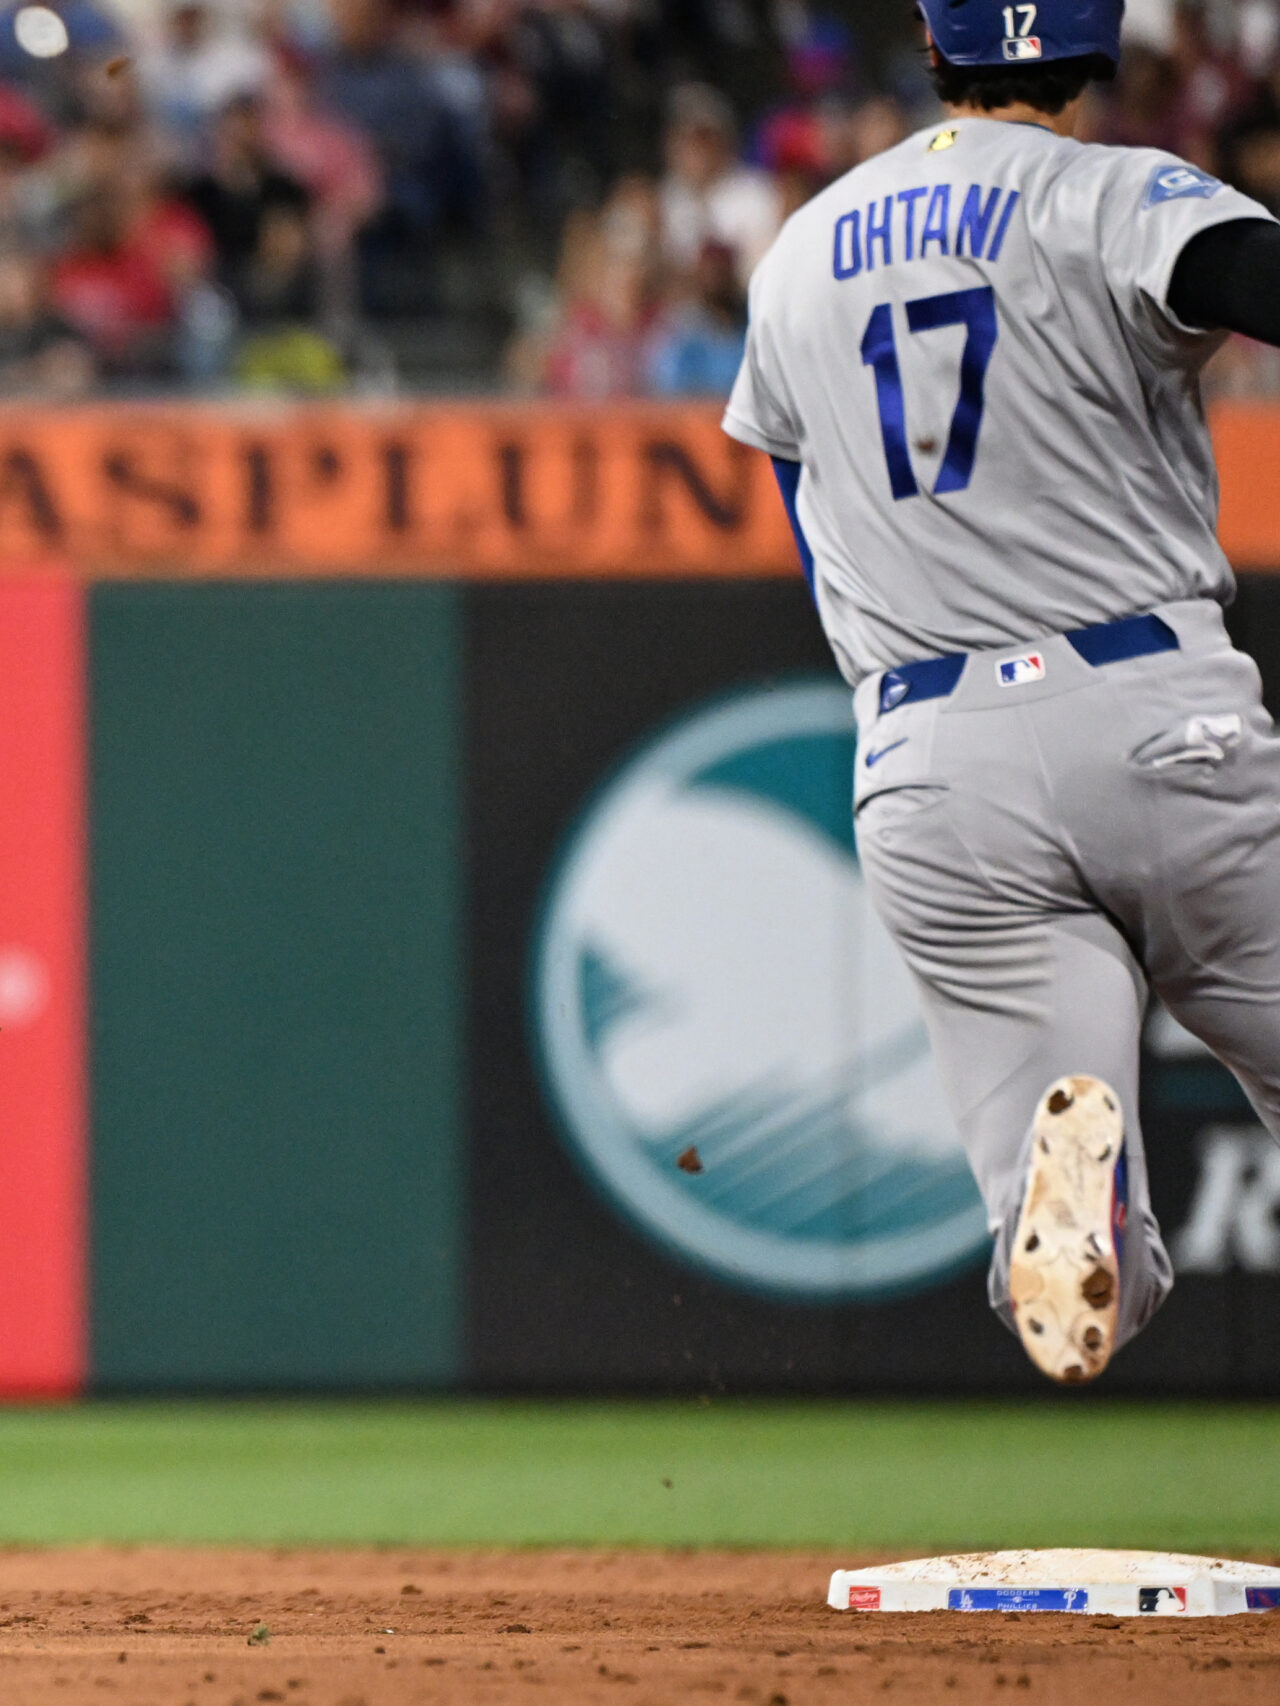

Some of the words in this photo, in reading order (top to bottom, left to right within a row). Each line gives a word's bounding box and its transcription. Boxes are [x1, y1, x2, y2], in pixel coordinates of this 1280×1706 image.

[1003, 4, 1037, 38] 17
[832, 183, 1020, 281] OHTANI
[860, 285, 999, 501] 17
